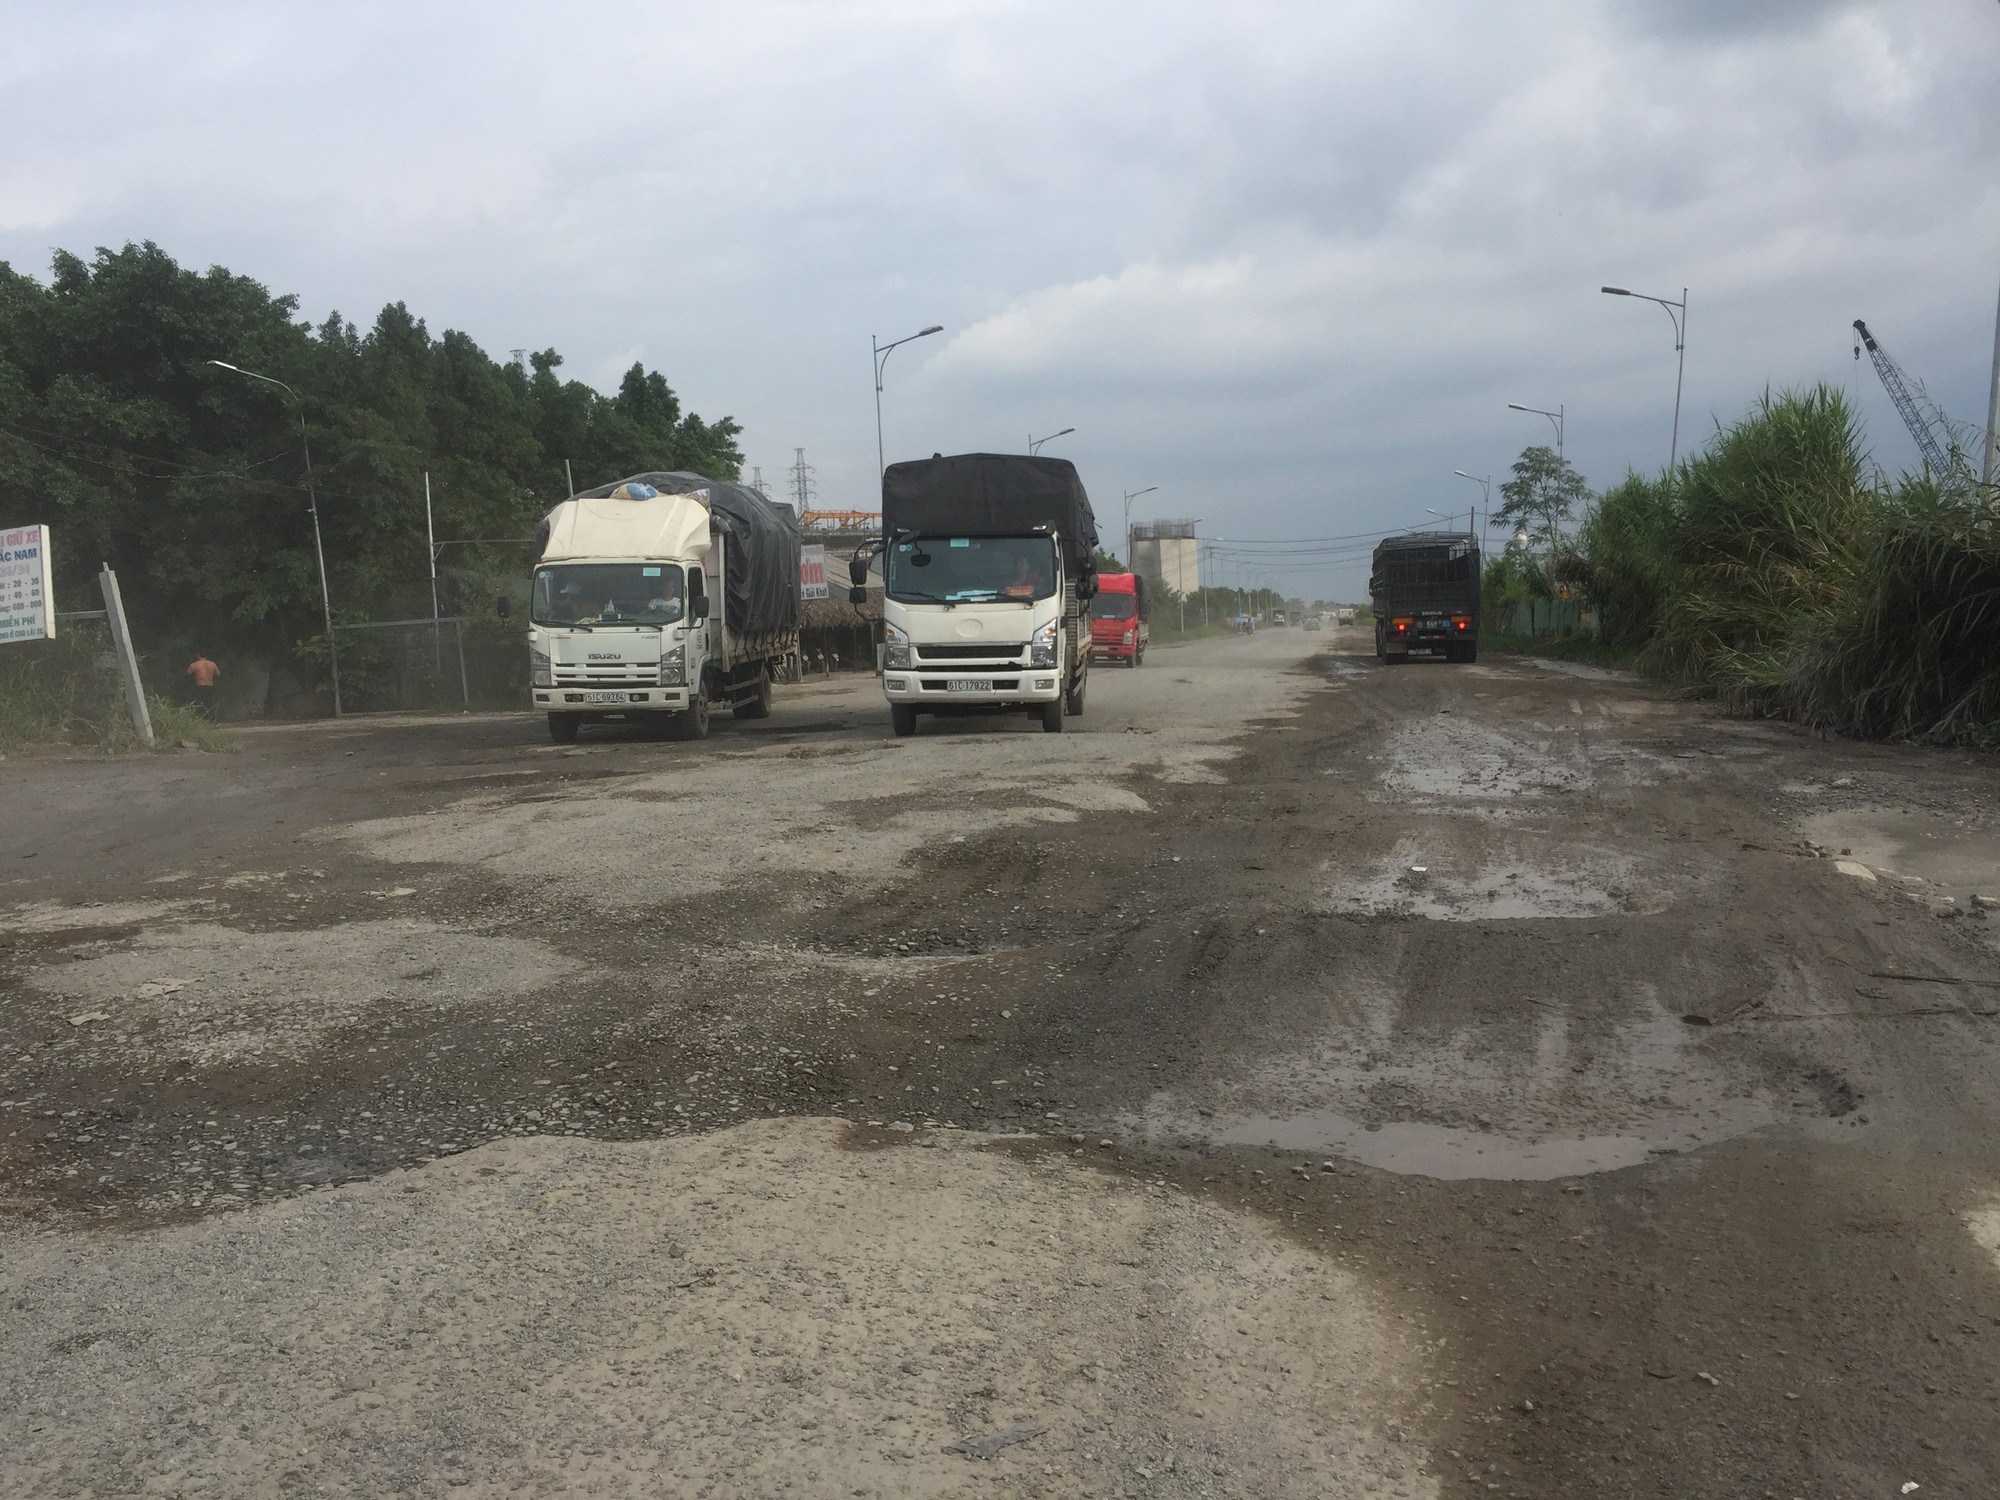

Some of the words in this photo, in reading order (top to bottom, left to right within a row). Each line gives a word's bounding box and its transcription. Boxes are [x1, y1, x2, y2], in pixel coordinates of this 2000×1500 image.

[26, 530, 38, 544] XE
[14, 548, 37, 560] NAM
[13, 579, 21, 588] 20
[31, 577, 39, 585] 30
[14, 590, 22, 599] 40
[22, 613, 35, 625] PHÍ
